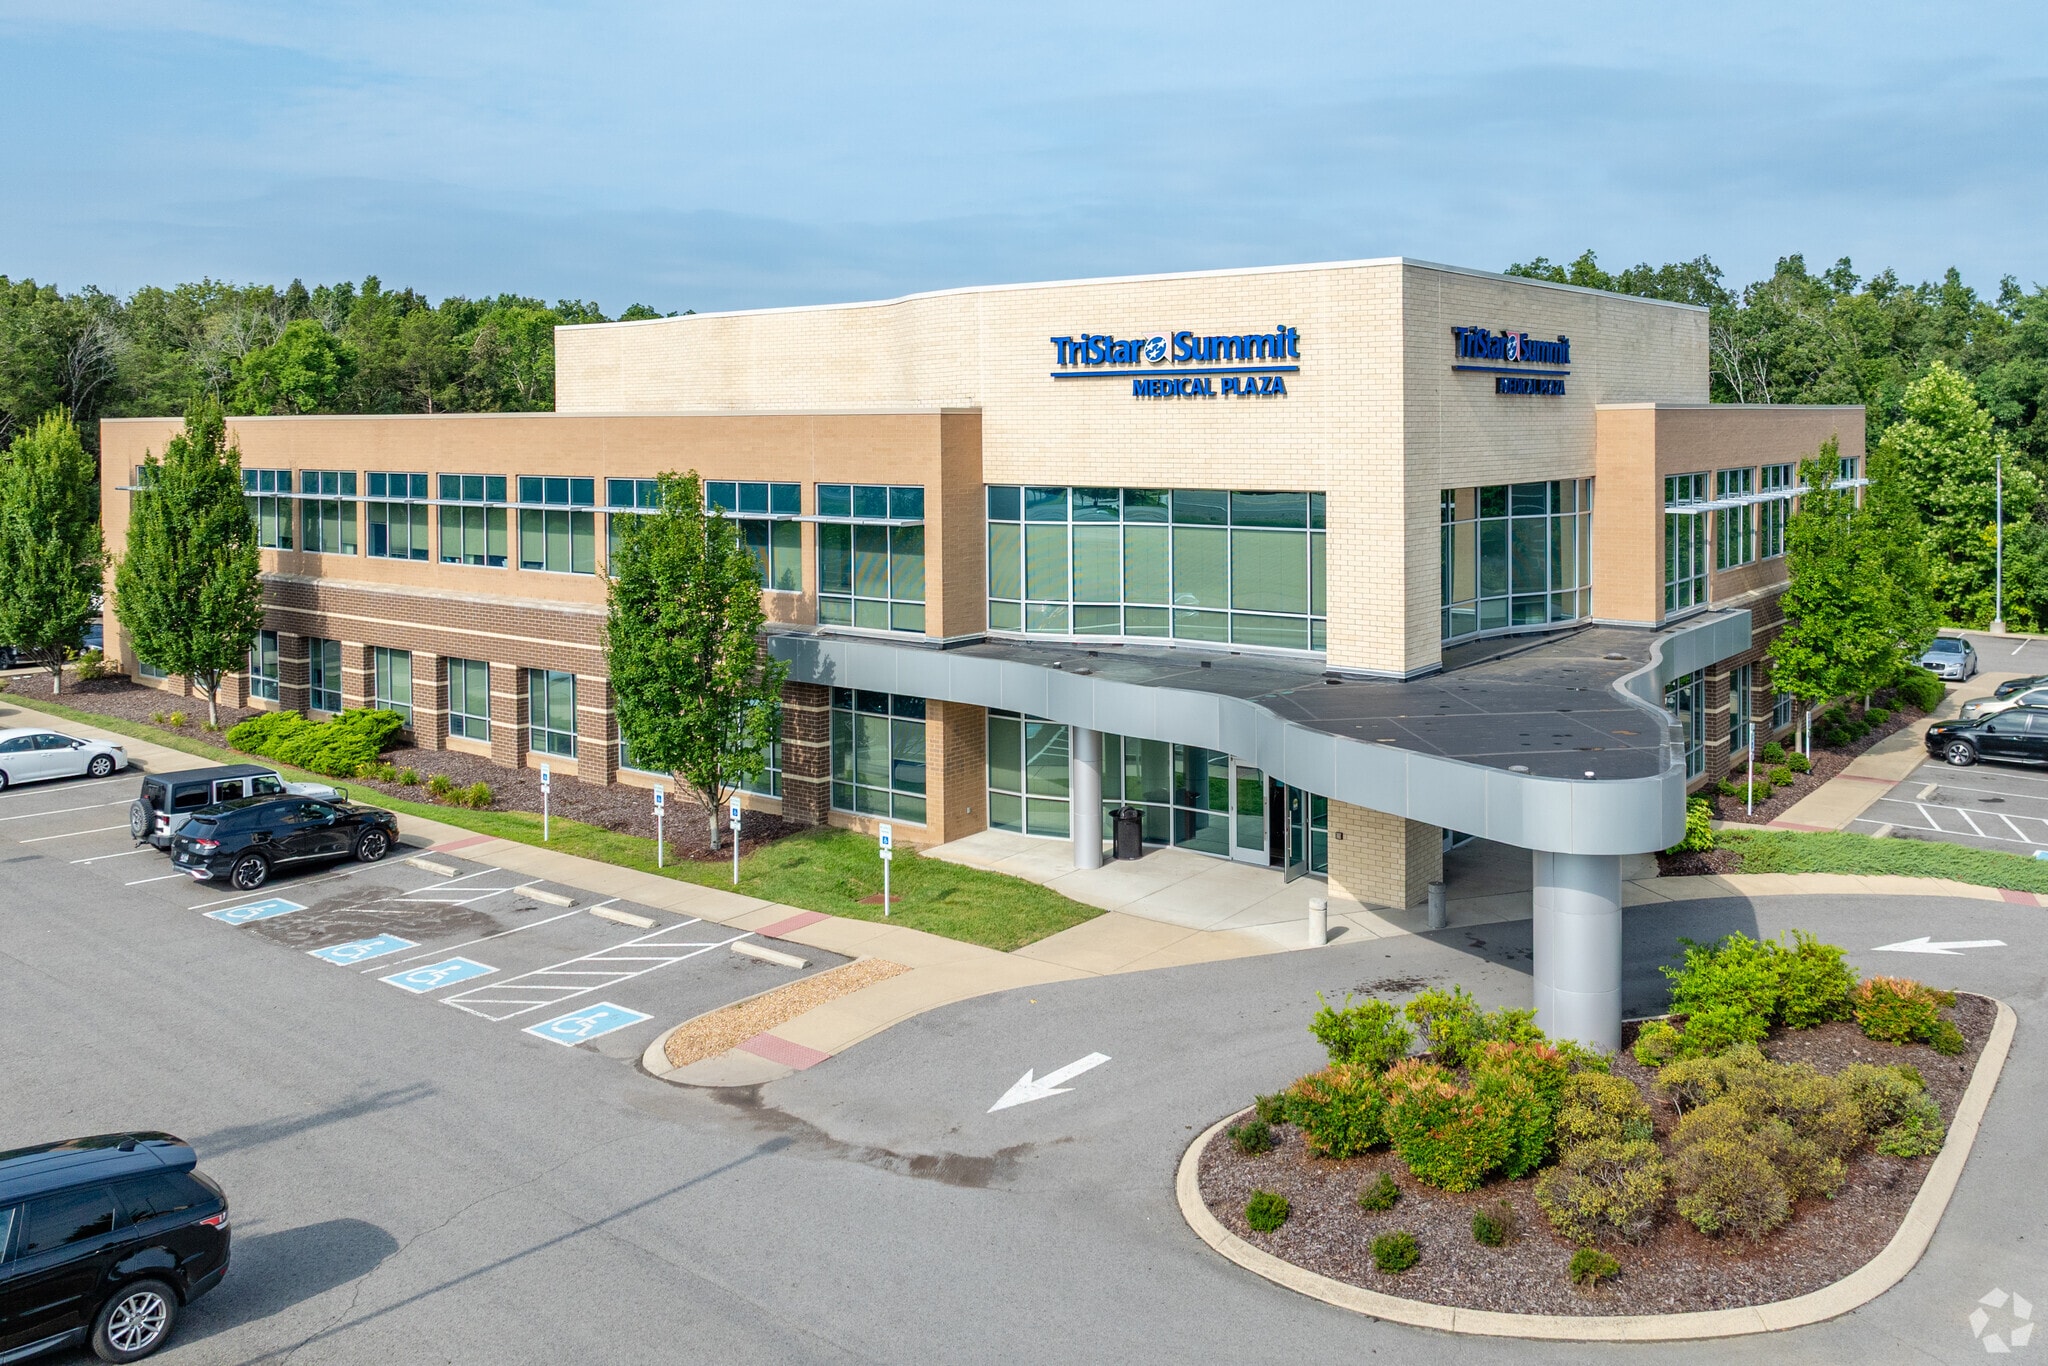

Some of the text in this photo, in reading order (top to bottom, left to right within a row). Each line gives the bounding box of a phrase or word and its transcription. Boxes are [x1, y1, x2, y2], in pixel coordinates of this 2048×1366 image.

[1050, 324, 1301, 365] TriStar Summit
[1451, 326, 1571, 364] TriStar Summit
[1132, 376, 1287, 397] MEDICAL PLAZA
